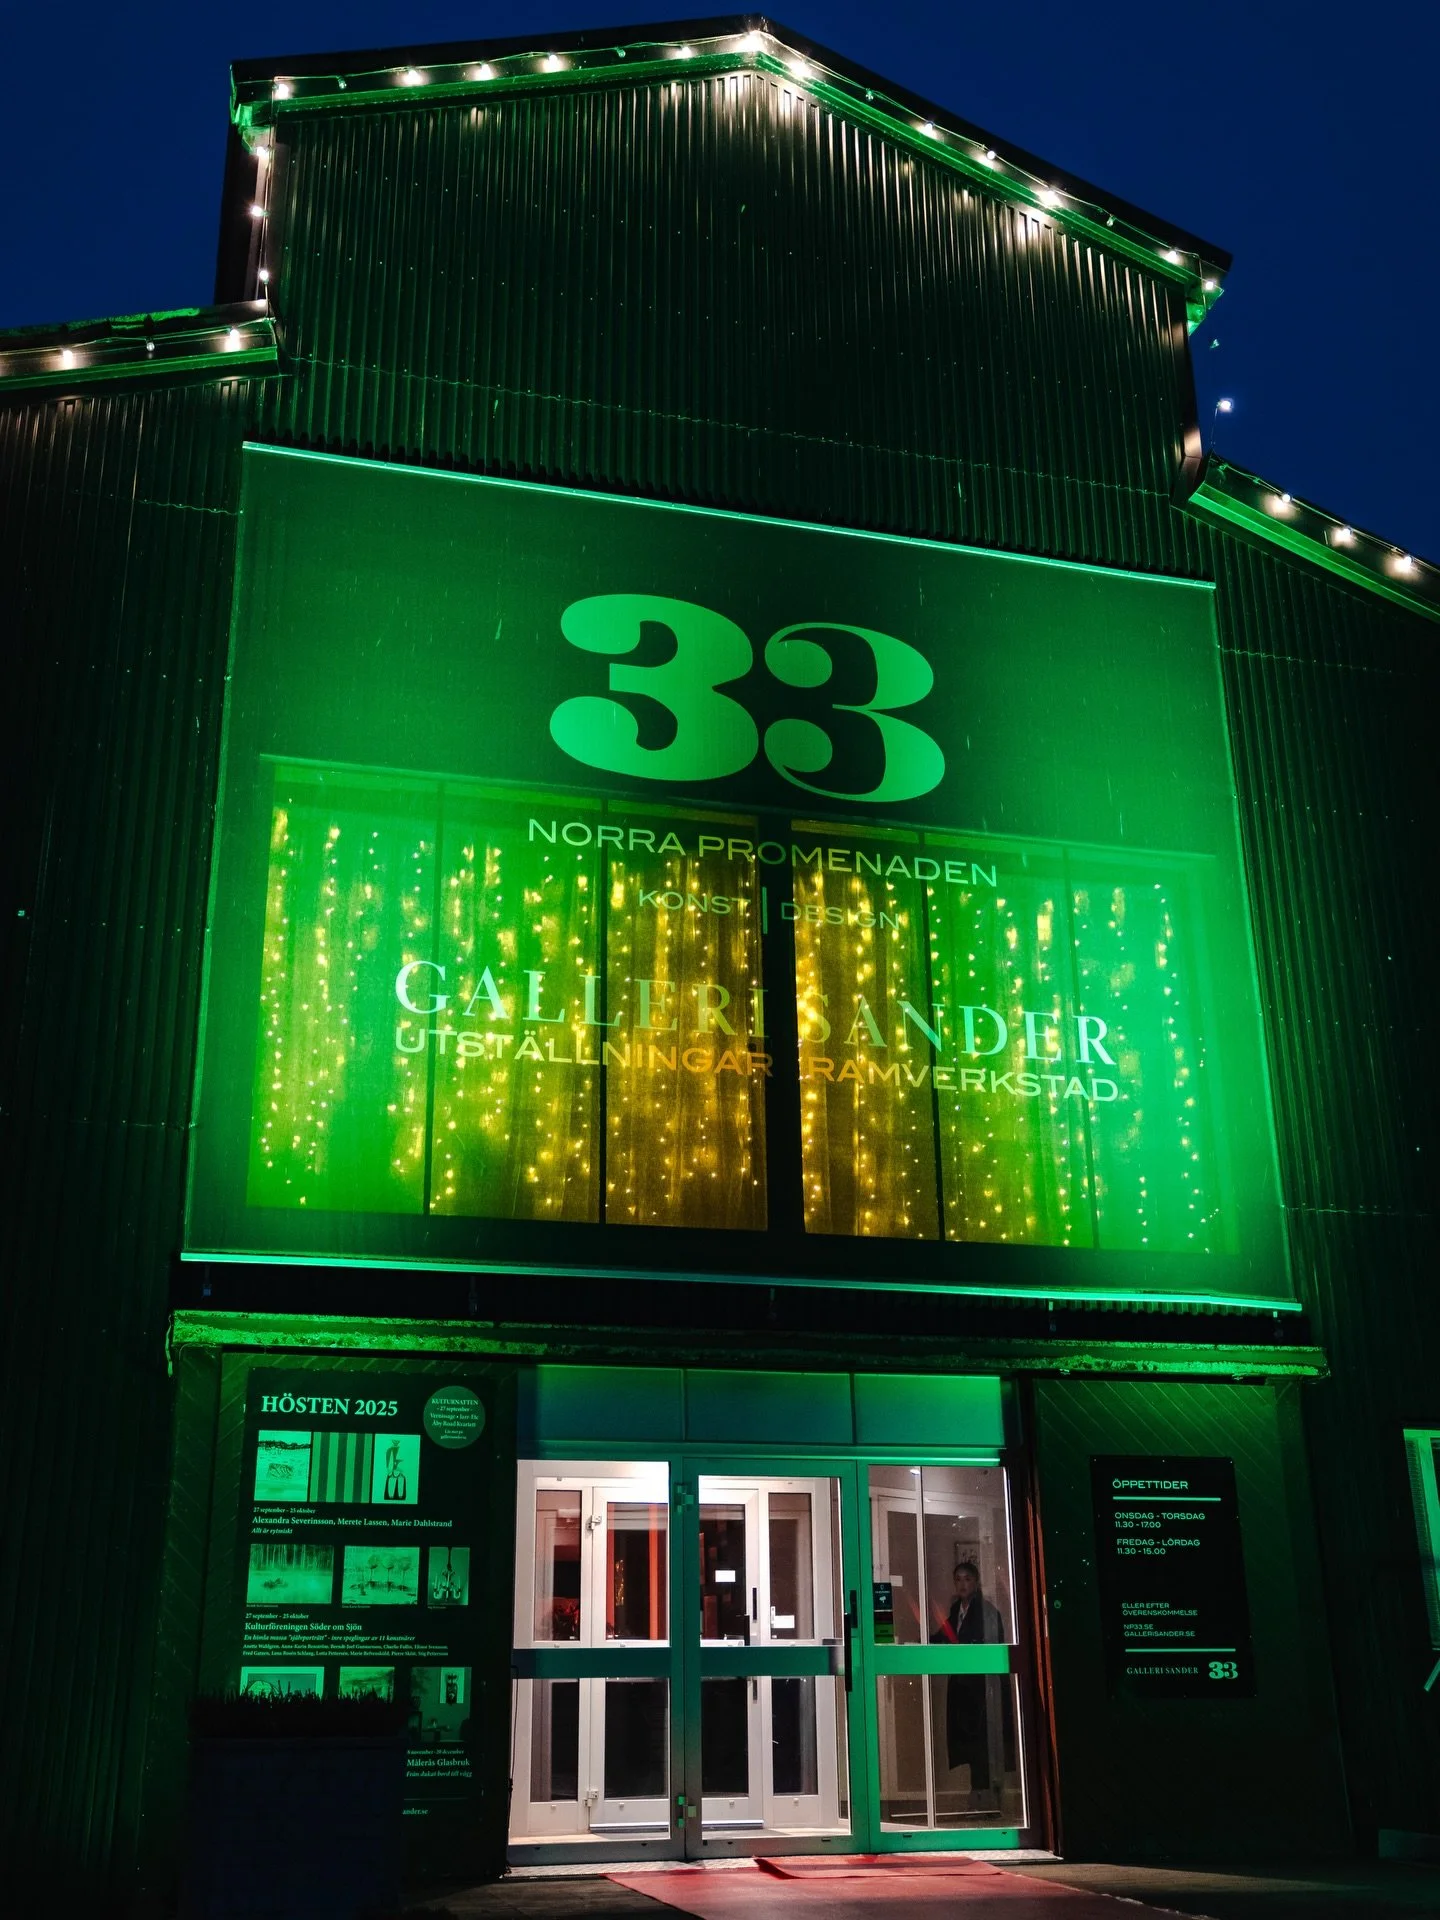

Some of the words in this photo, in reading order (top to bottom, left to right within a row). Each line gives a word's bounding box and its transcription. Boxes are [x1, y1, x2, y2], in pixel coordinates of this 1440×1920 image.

[549, 594, 945, 802] 33
[527, 818, 687, 857] NORRA
[698, 835, 997, 887] PROMENADEN
[638, 888, 751, 916] KONST
[781, 902, 900, 930] DESIGN
[395, 960, 770, 1038] GALLERI
[798, 993, 1117, 1065] SANDER
[395, 1026, 773, 1077] UTSTÄLLNINGAR
[807, 1056, 1119, 1102] RAMVERKSTAD
[261, 1393, 350, 1415] HÖSTEN
[354, 1400, 398, 1416] 2025
[1112, 1478, 1189, 1490] ÖPPETTIDER
[252, 1516, 290, 1524] Alexandra
[291, 1517, 336, 1526] Severinsson,
[337, 1518, 362, 1526] Merete
[363, 1518, 389, 1527] Lassen,
[391, 1519, 412, 1527] Marie
[413, 1519, 453, 1528] Dahlstrand
[1114, 1512, 1154, 1520] ONSDAG
[1161, 1512, 1205, 1520] TORSDAG
[1161, 1538, 1200, 1546] LÖRDAG
[245, 1622, 308, 1632] Kulturföreningen
[310, 1623, 331, 1631] Söder
[346, 1623, 362, 1632] Sjön
[1126, 1667, 1163, 1675] GALLERI
[1165, 1667, 1199, 1675] SANDER
[1208, 1661, 1239, 1680] 33
[407, 1758, 435, 1767] Målerås
[437, 1757, 470, 1766] Glasbruk
